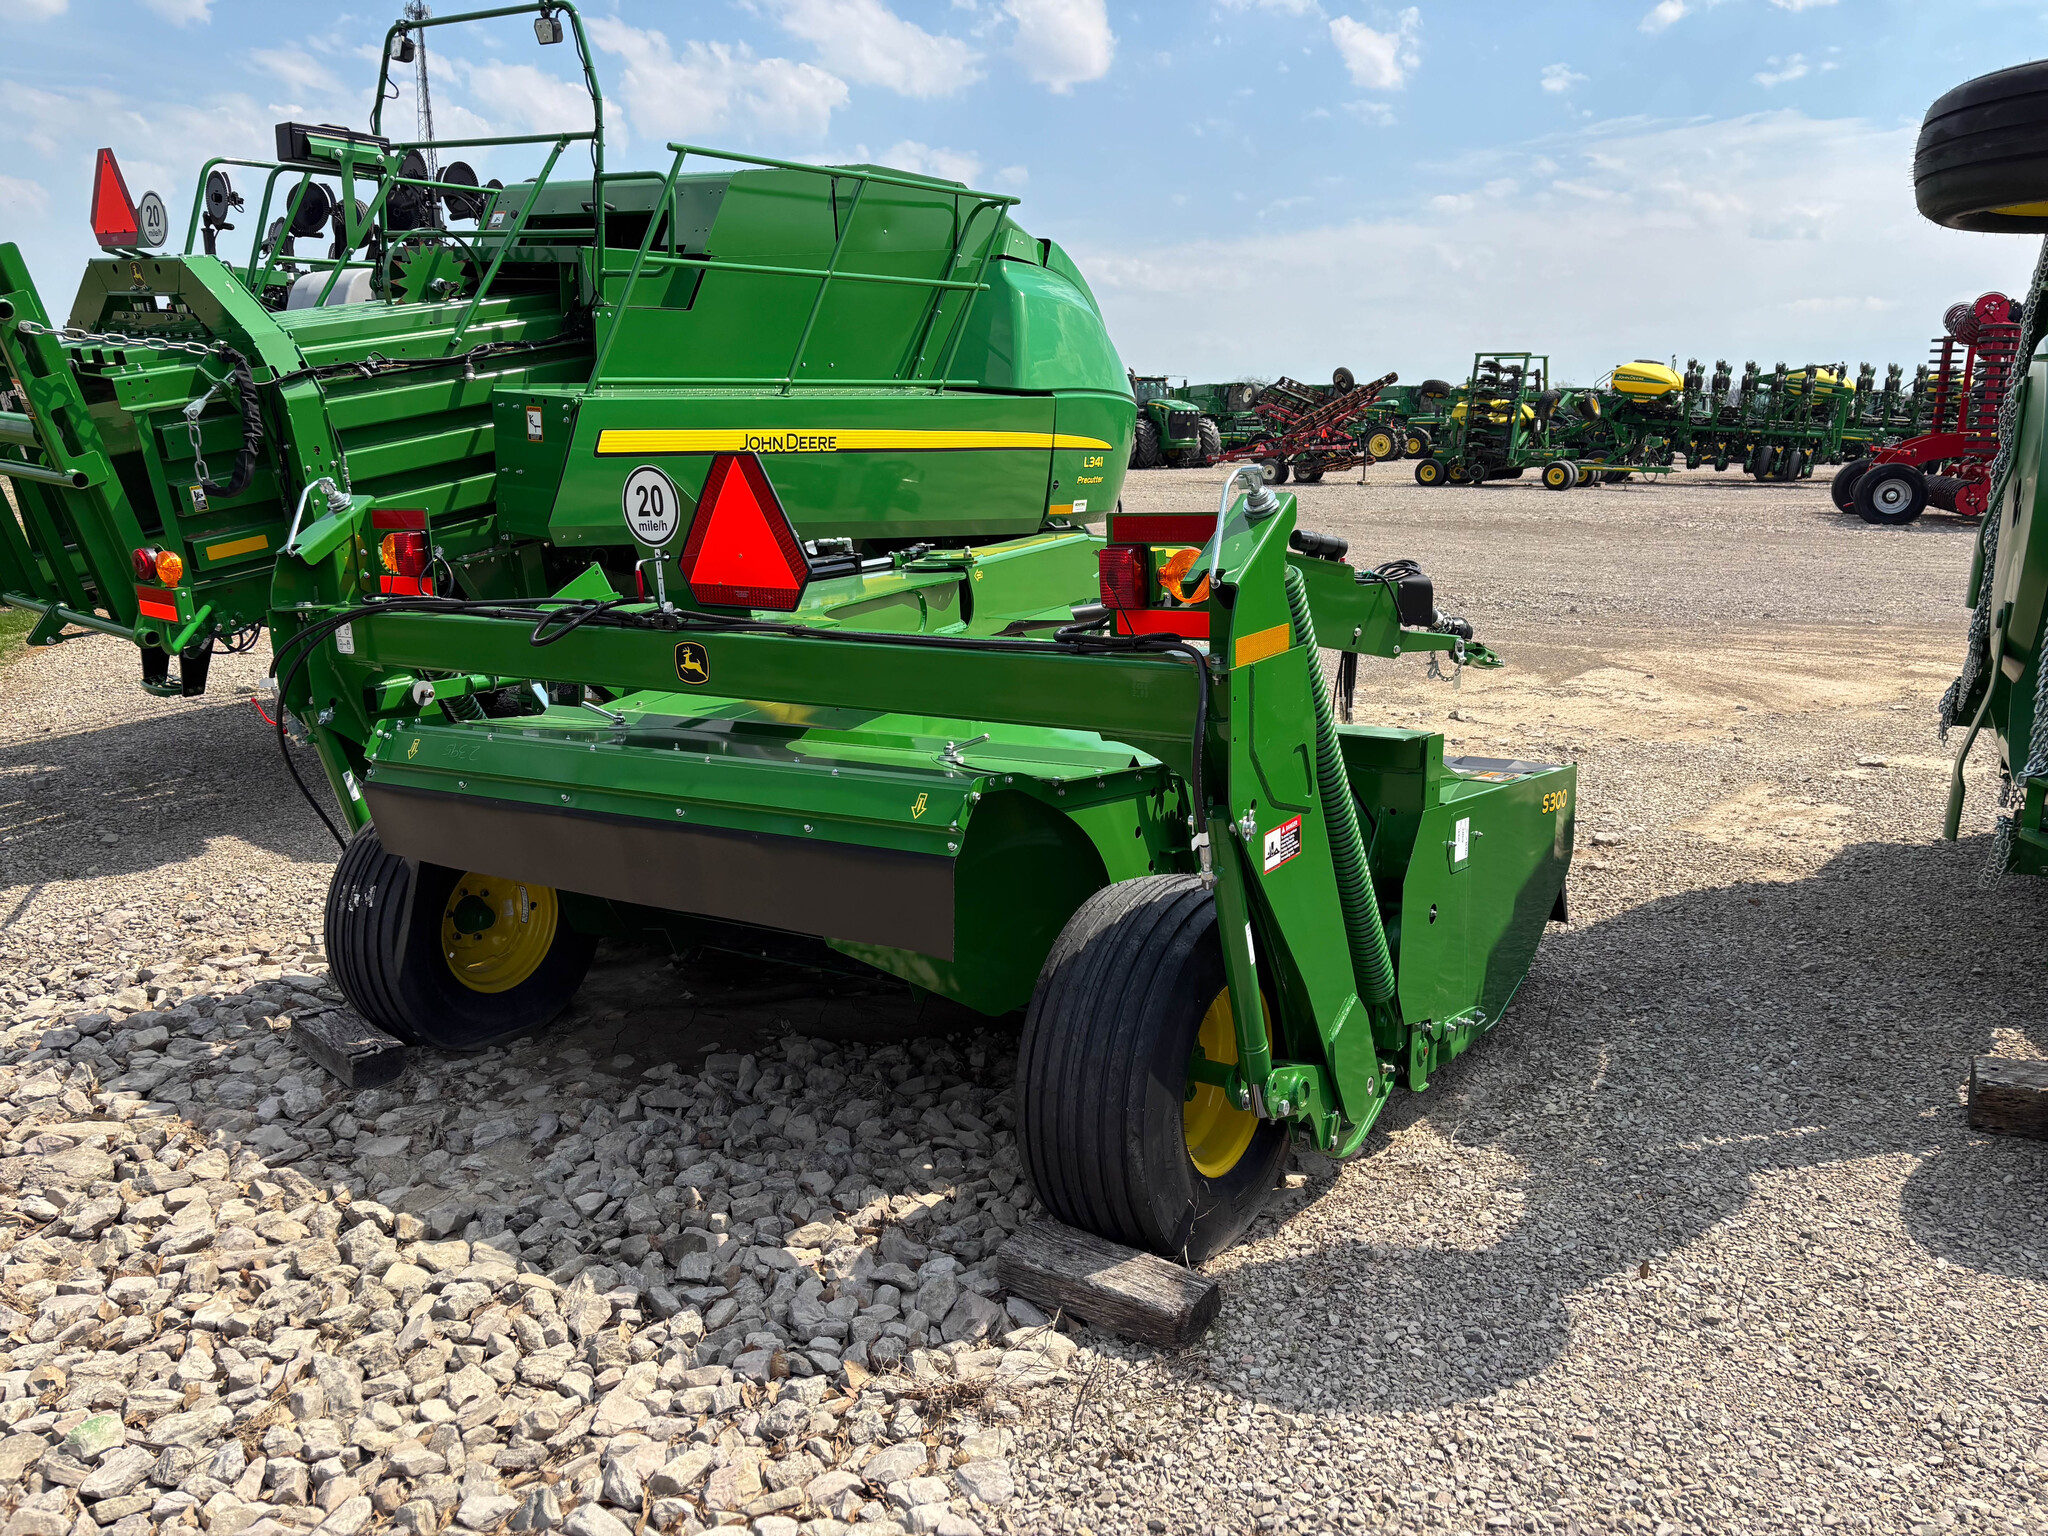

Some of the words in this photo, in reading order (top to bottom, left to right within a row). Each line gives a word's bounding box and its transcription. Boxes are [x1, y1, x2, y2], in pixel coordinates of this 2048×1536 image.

[146, 205, 160, 227] 20
[739, 433, 783, 451] JOHN
[786, 433, 837, 450] DEERE
[1083, 456, 1104, 468] L341
[1076, 475, 1104, 485] Precutter
[636, 484, 664, 517] 20
[638, 520, 668, 531] mile/h
[1542, 788, 1568, 814] S300
